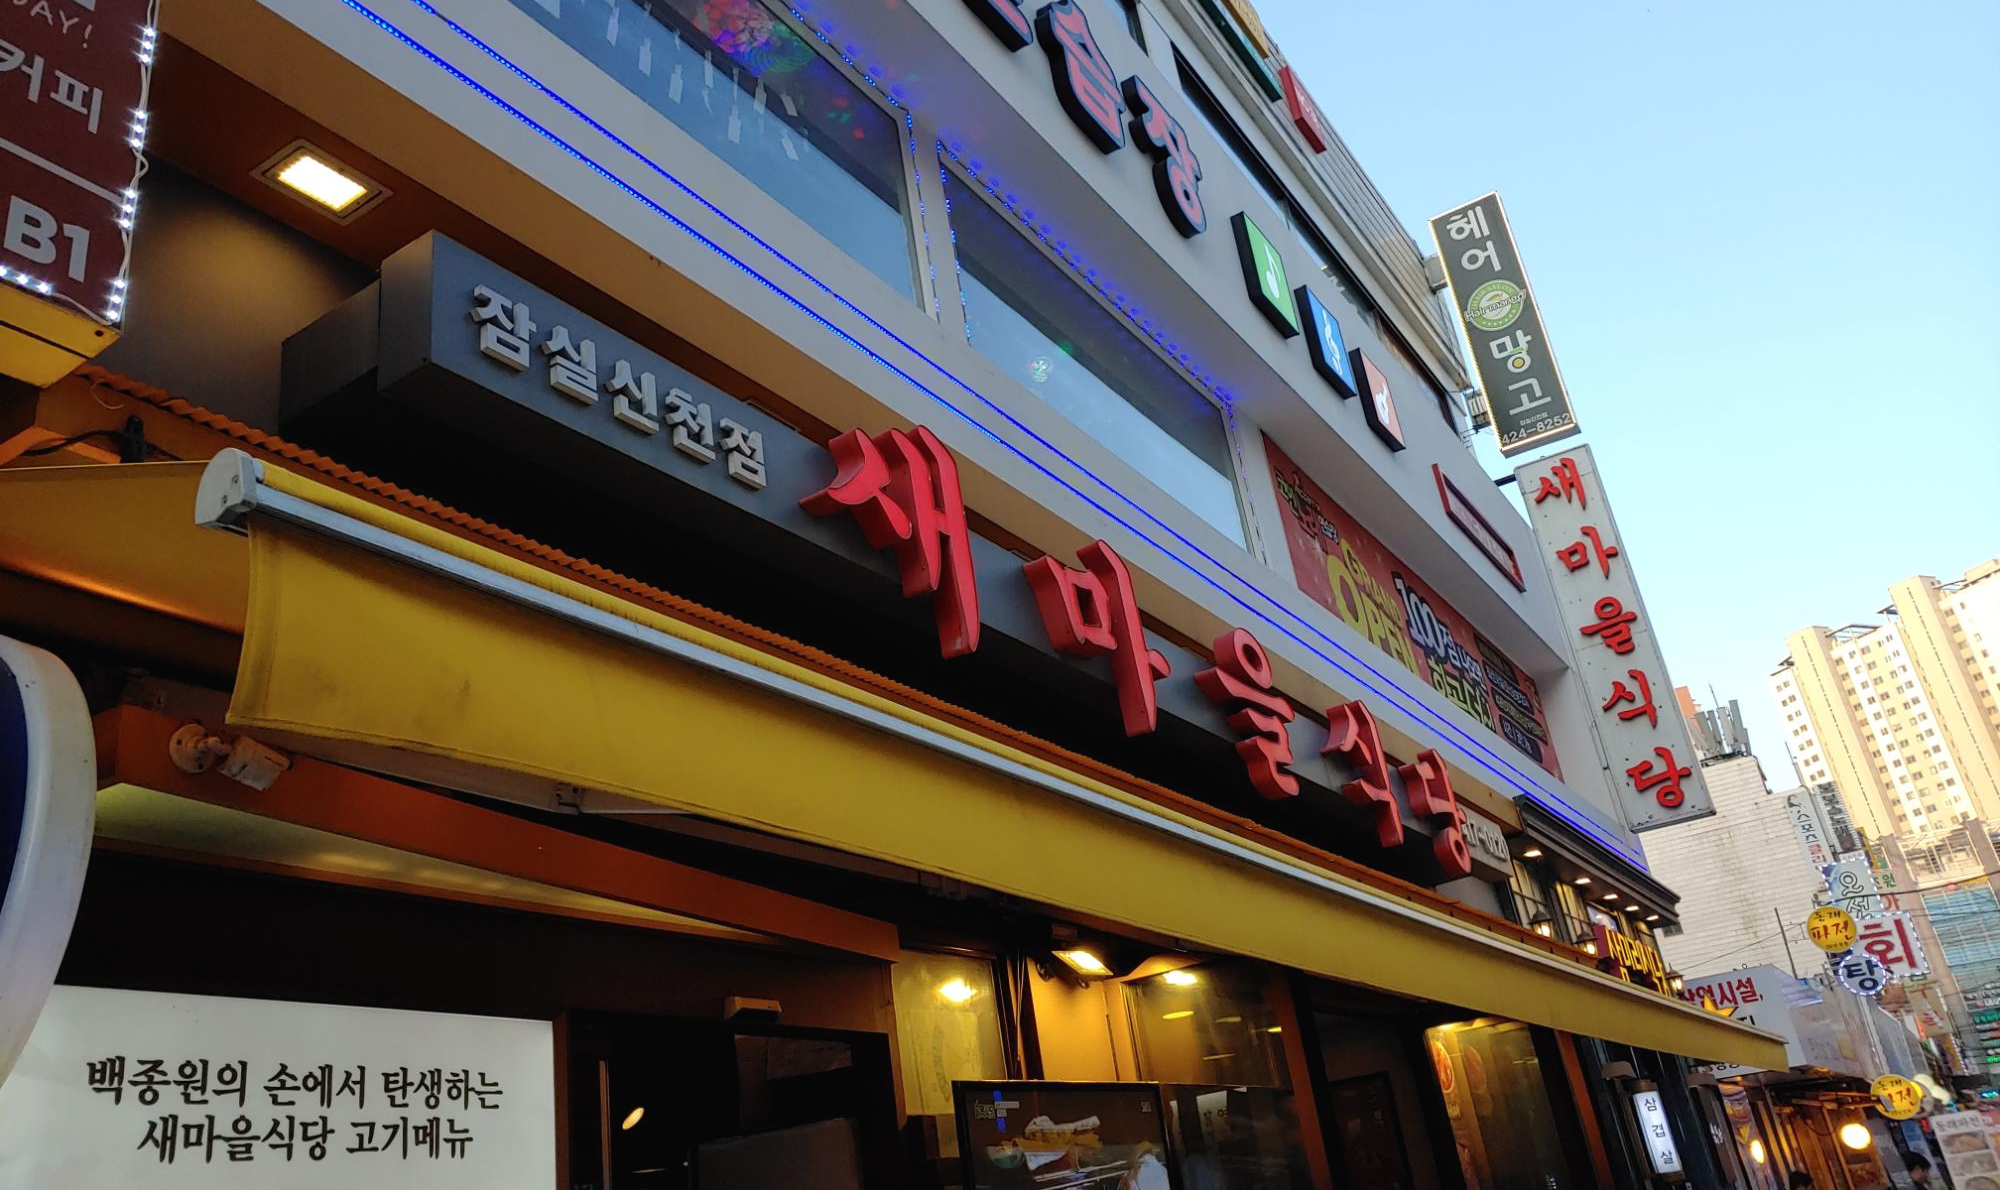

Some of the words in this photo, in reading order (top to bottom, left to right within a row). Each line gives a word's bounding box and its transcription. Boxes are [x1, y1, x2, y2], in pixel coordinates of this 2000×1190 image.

[13, 0, 92, 49] AY!
[0, 38, 103, 134] 커피
[968, 0, 1207, 235] 습장
[4, 195, 90, 283] B1
[1446, 205, 1502, 272] 헤어
[1489, 329, 1552, 416] 망고
[470, 284, 767, 490] 잠실신천점
[1501, 413, 1571, 443] 424-8252
[800, 425, 1474, 878] 새마을식당
[1327, 554, 1419, 676] OPEN
[1535, 458, 1692, 807] 새마을식당
[1810, 920, 1853, 940] 파전
[1859, 918, 1918, 969] 회
[1843, 960, 1880, 991] 탕
[86, 1055, 248, 1108] 백종원의
[262, 1062, 366, 1110] 손에서
[380, 1066, 504, 1111] 탄생하는
[136, 1113, 336, 1165] 새마을식당
[345, 1115, 474, 1161] 고기메뉴
[1644, 1097, 1674, 1165] 삼겹살
